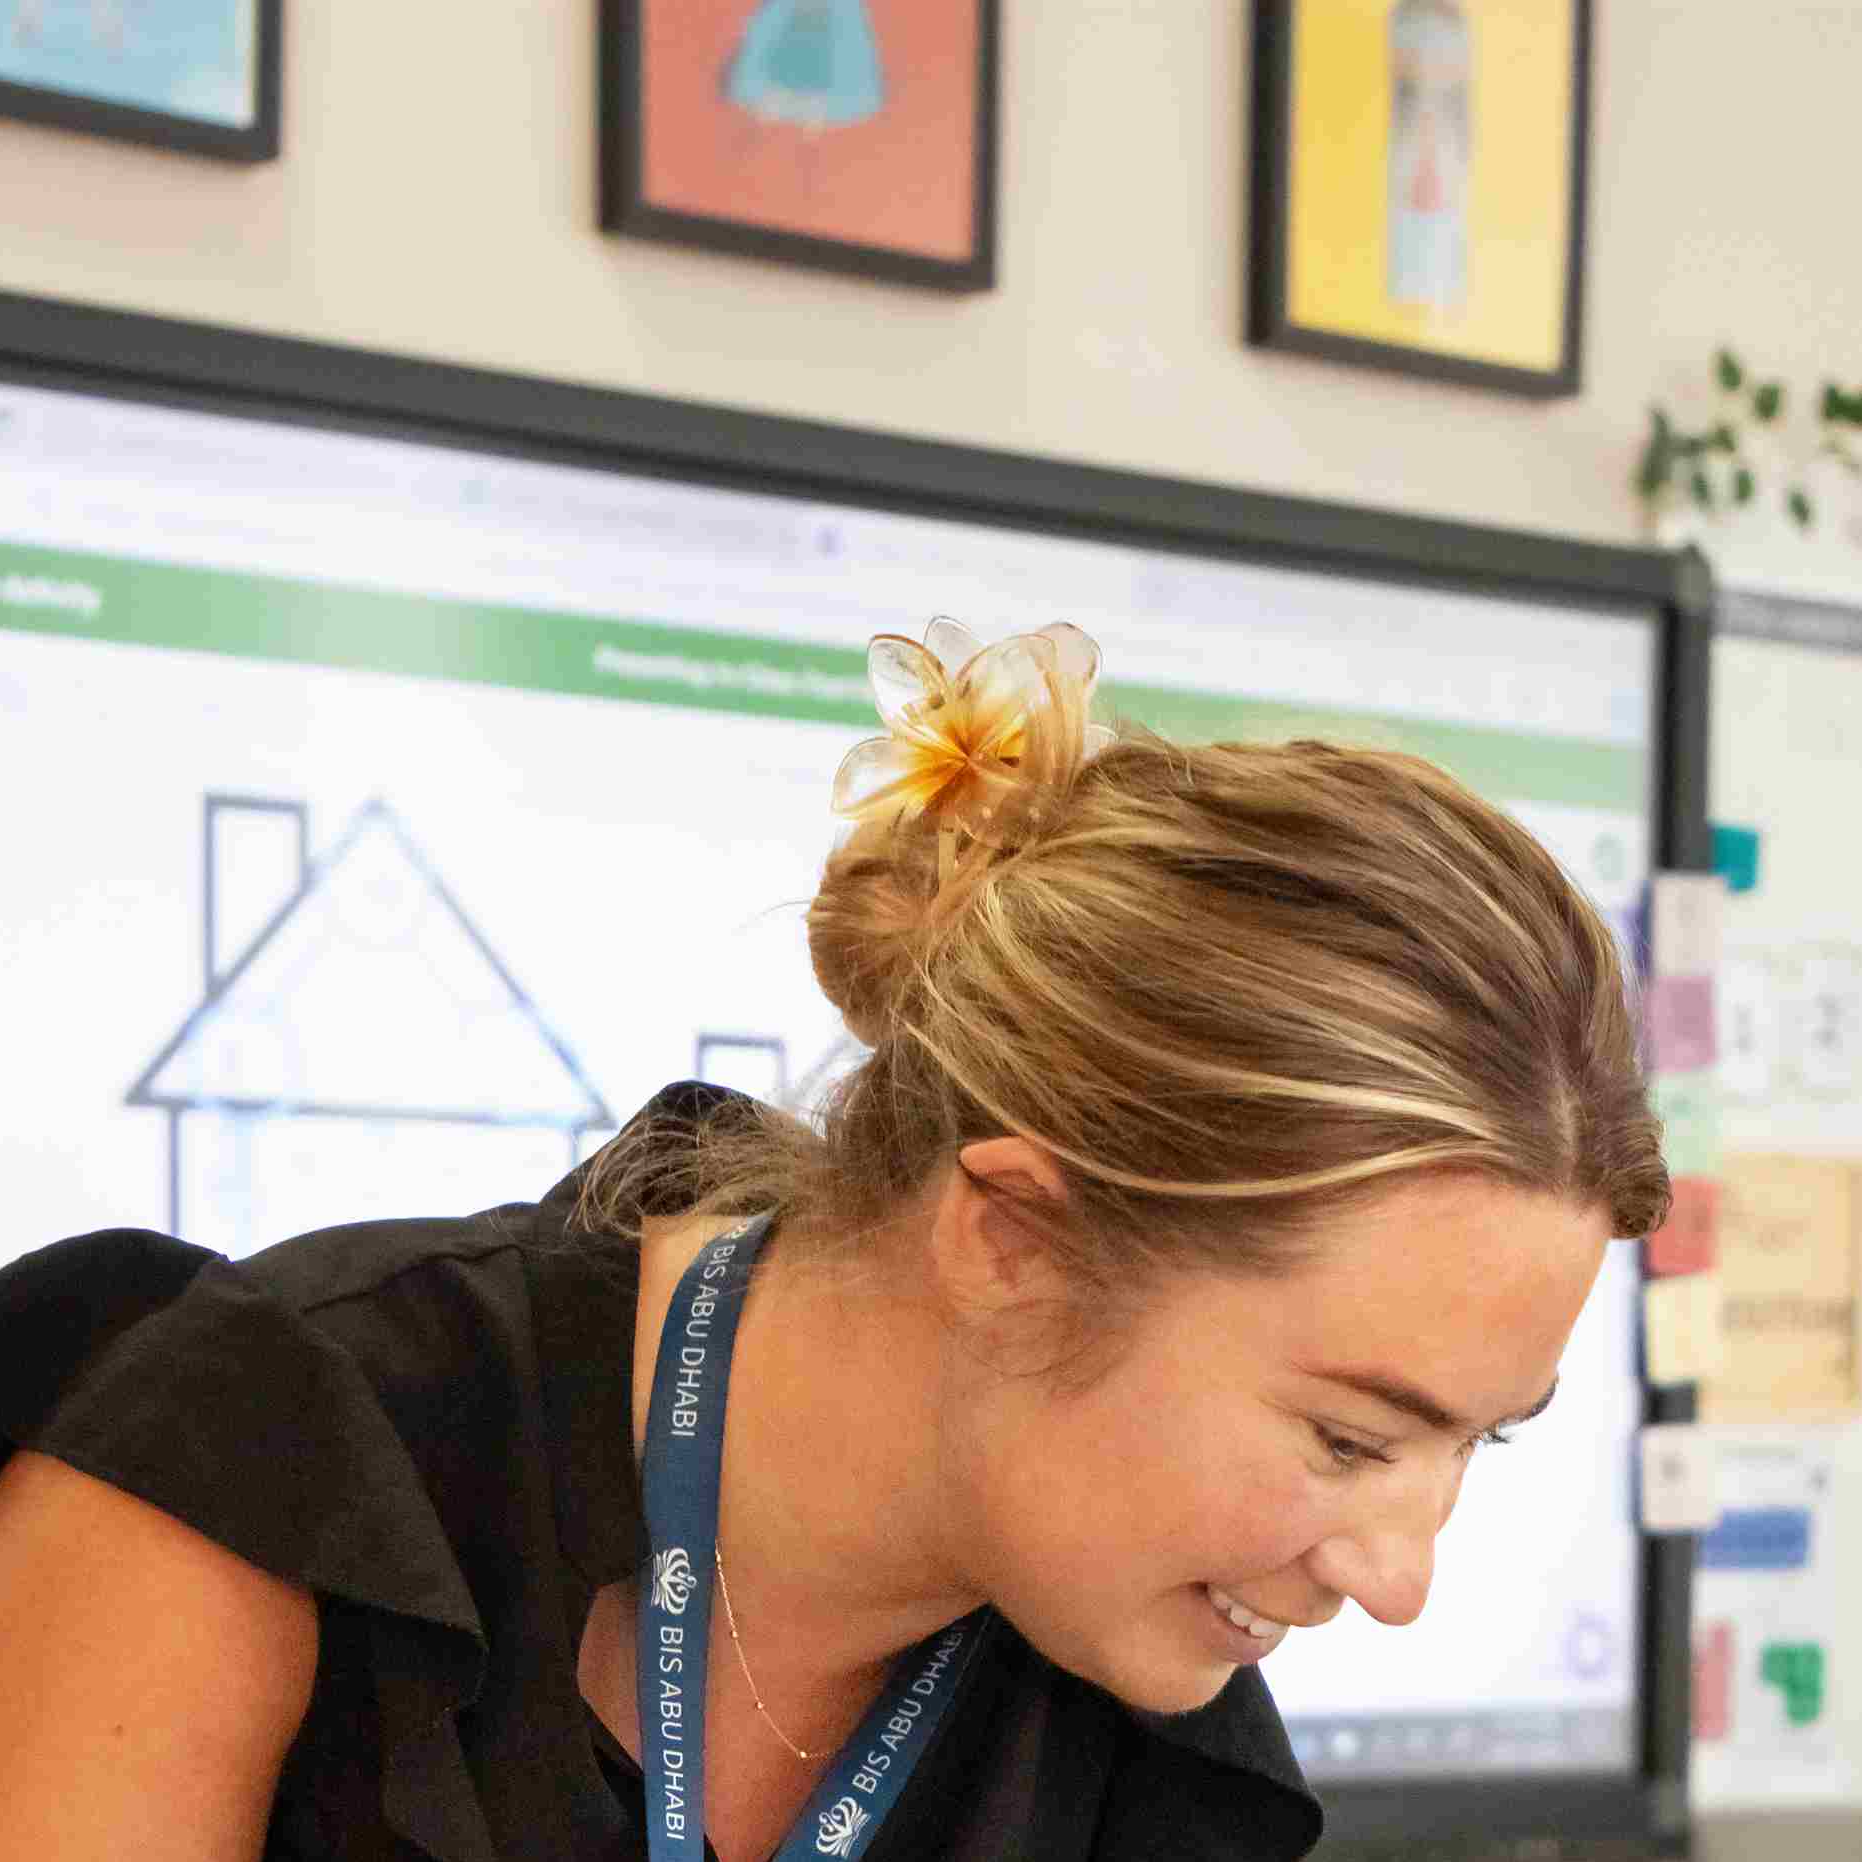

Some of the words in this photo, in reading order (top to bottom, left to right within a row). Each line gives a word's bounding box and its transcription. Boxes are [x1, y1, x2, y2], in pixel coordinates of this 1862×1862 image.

[702, 1243, 737, 1280] BIS
[684, 1284, 718, 1338] ABU
[671, 1346, 706, 1438] DHABI
[659, 1626, 684, 1673] BIS
[659, 1680, 684, 1743] ABU
[851, 1750, 891, 1794] BIS
[880, 1698, 923, 1752] ABU
[911, 1626, 965, 1697] DHAB
[662, 1749, 685, 1840] DHABI
